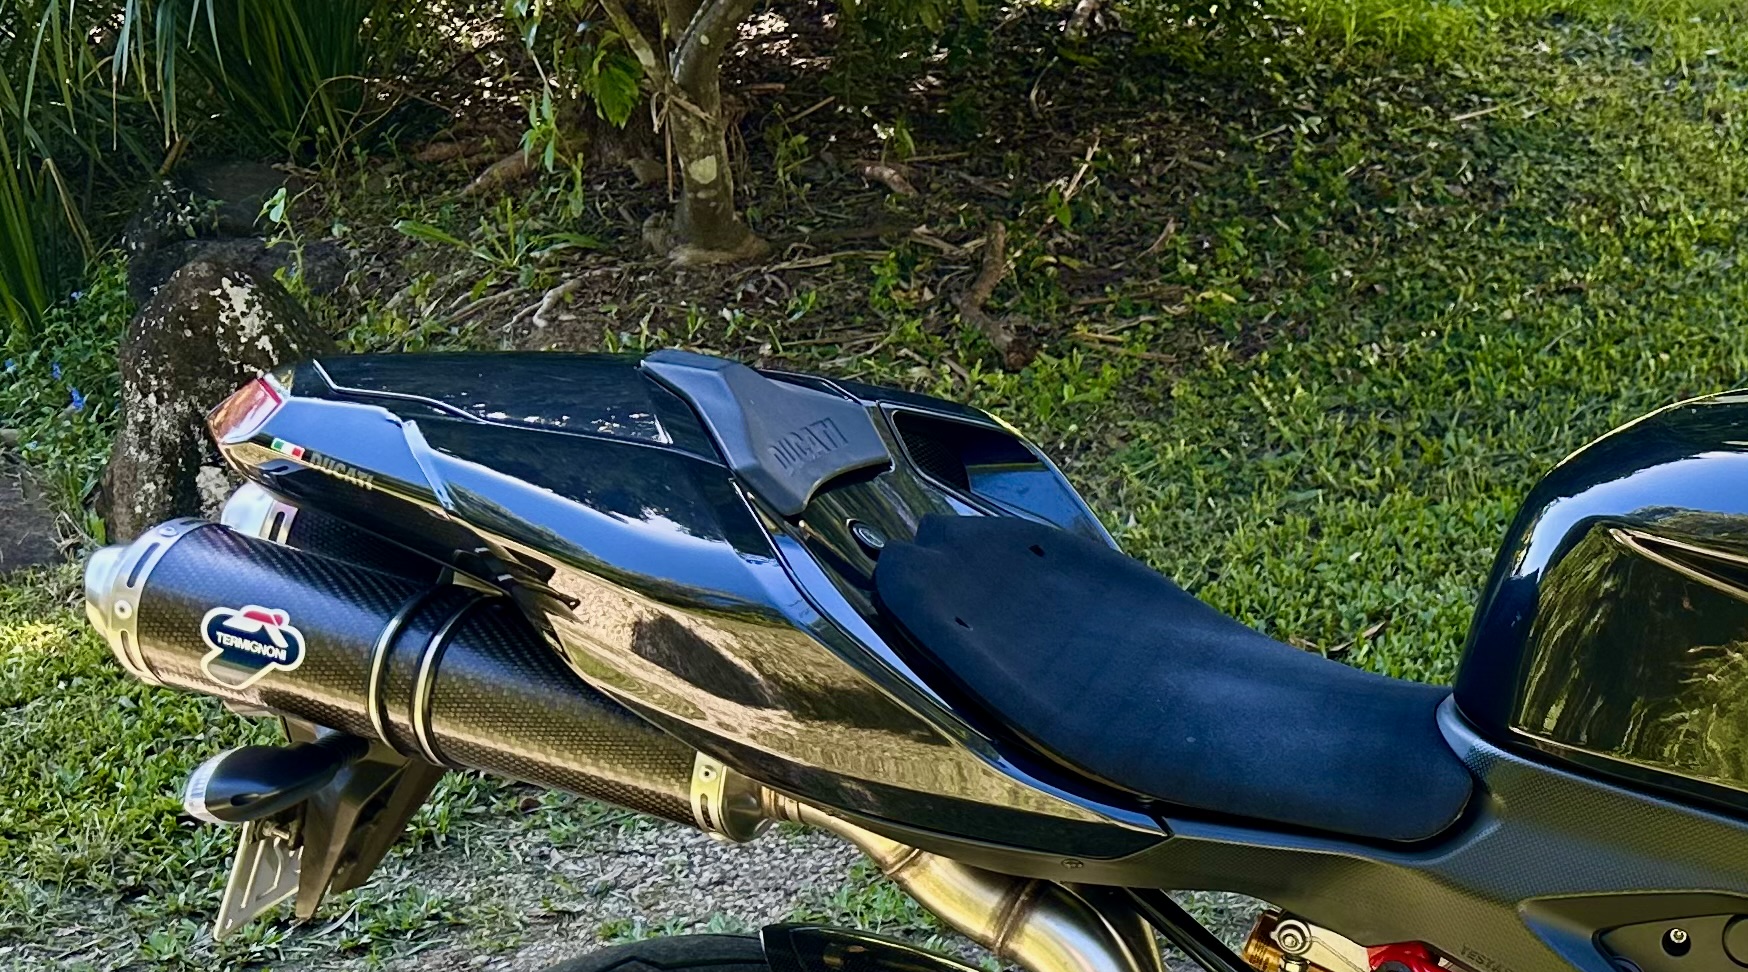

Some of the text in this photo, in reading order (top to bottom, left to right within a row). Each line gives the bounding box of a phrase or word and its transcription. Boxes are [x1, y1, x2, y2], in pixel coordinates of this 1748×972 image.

[768, 417, 848, 477] DUCATI
[310, 452, 374, 486] DUCATI
[216, 630, 287, 661] TERMIGNONI
